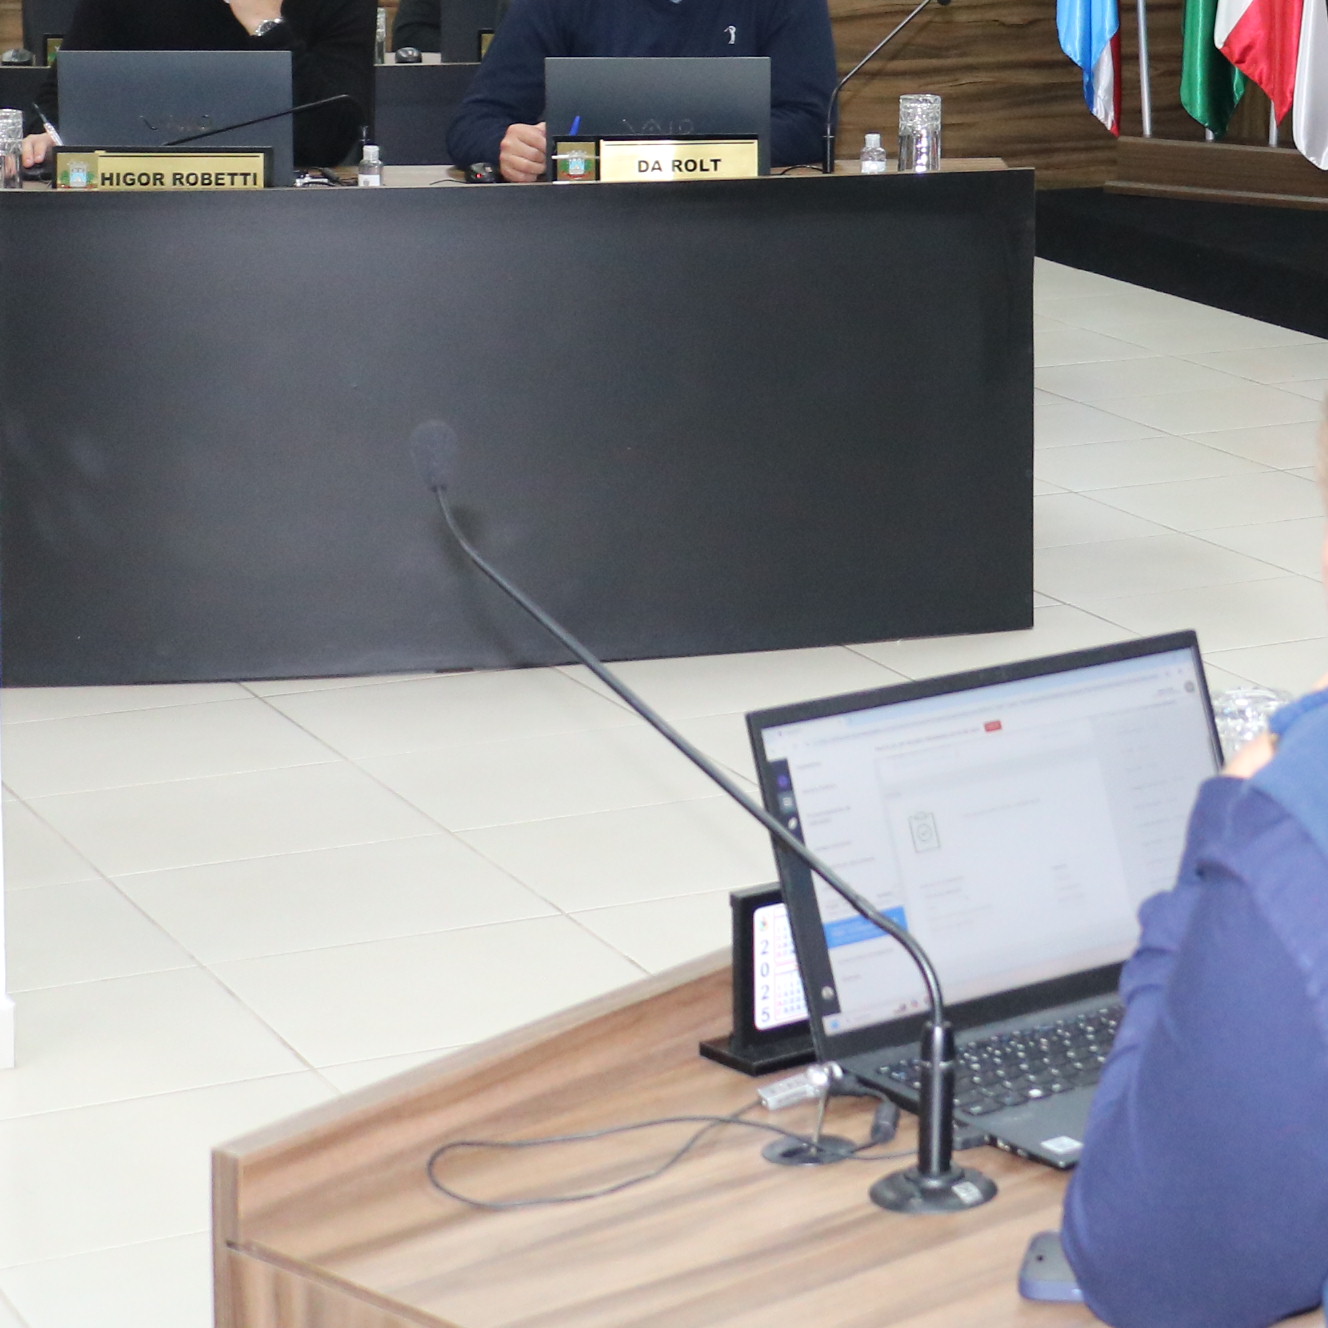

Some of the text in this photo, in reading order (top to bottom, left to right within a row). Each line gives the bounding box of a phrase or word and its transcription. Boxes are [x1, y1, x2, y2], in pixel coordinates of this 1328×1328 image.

[637, 158, 722, 173] DA ROLT
[100, 172, 258, 187] HIGOR ROBETTI
